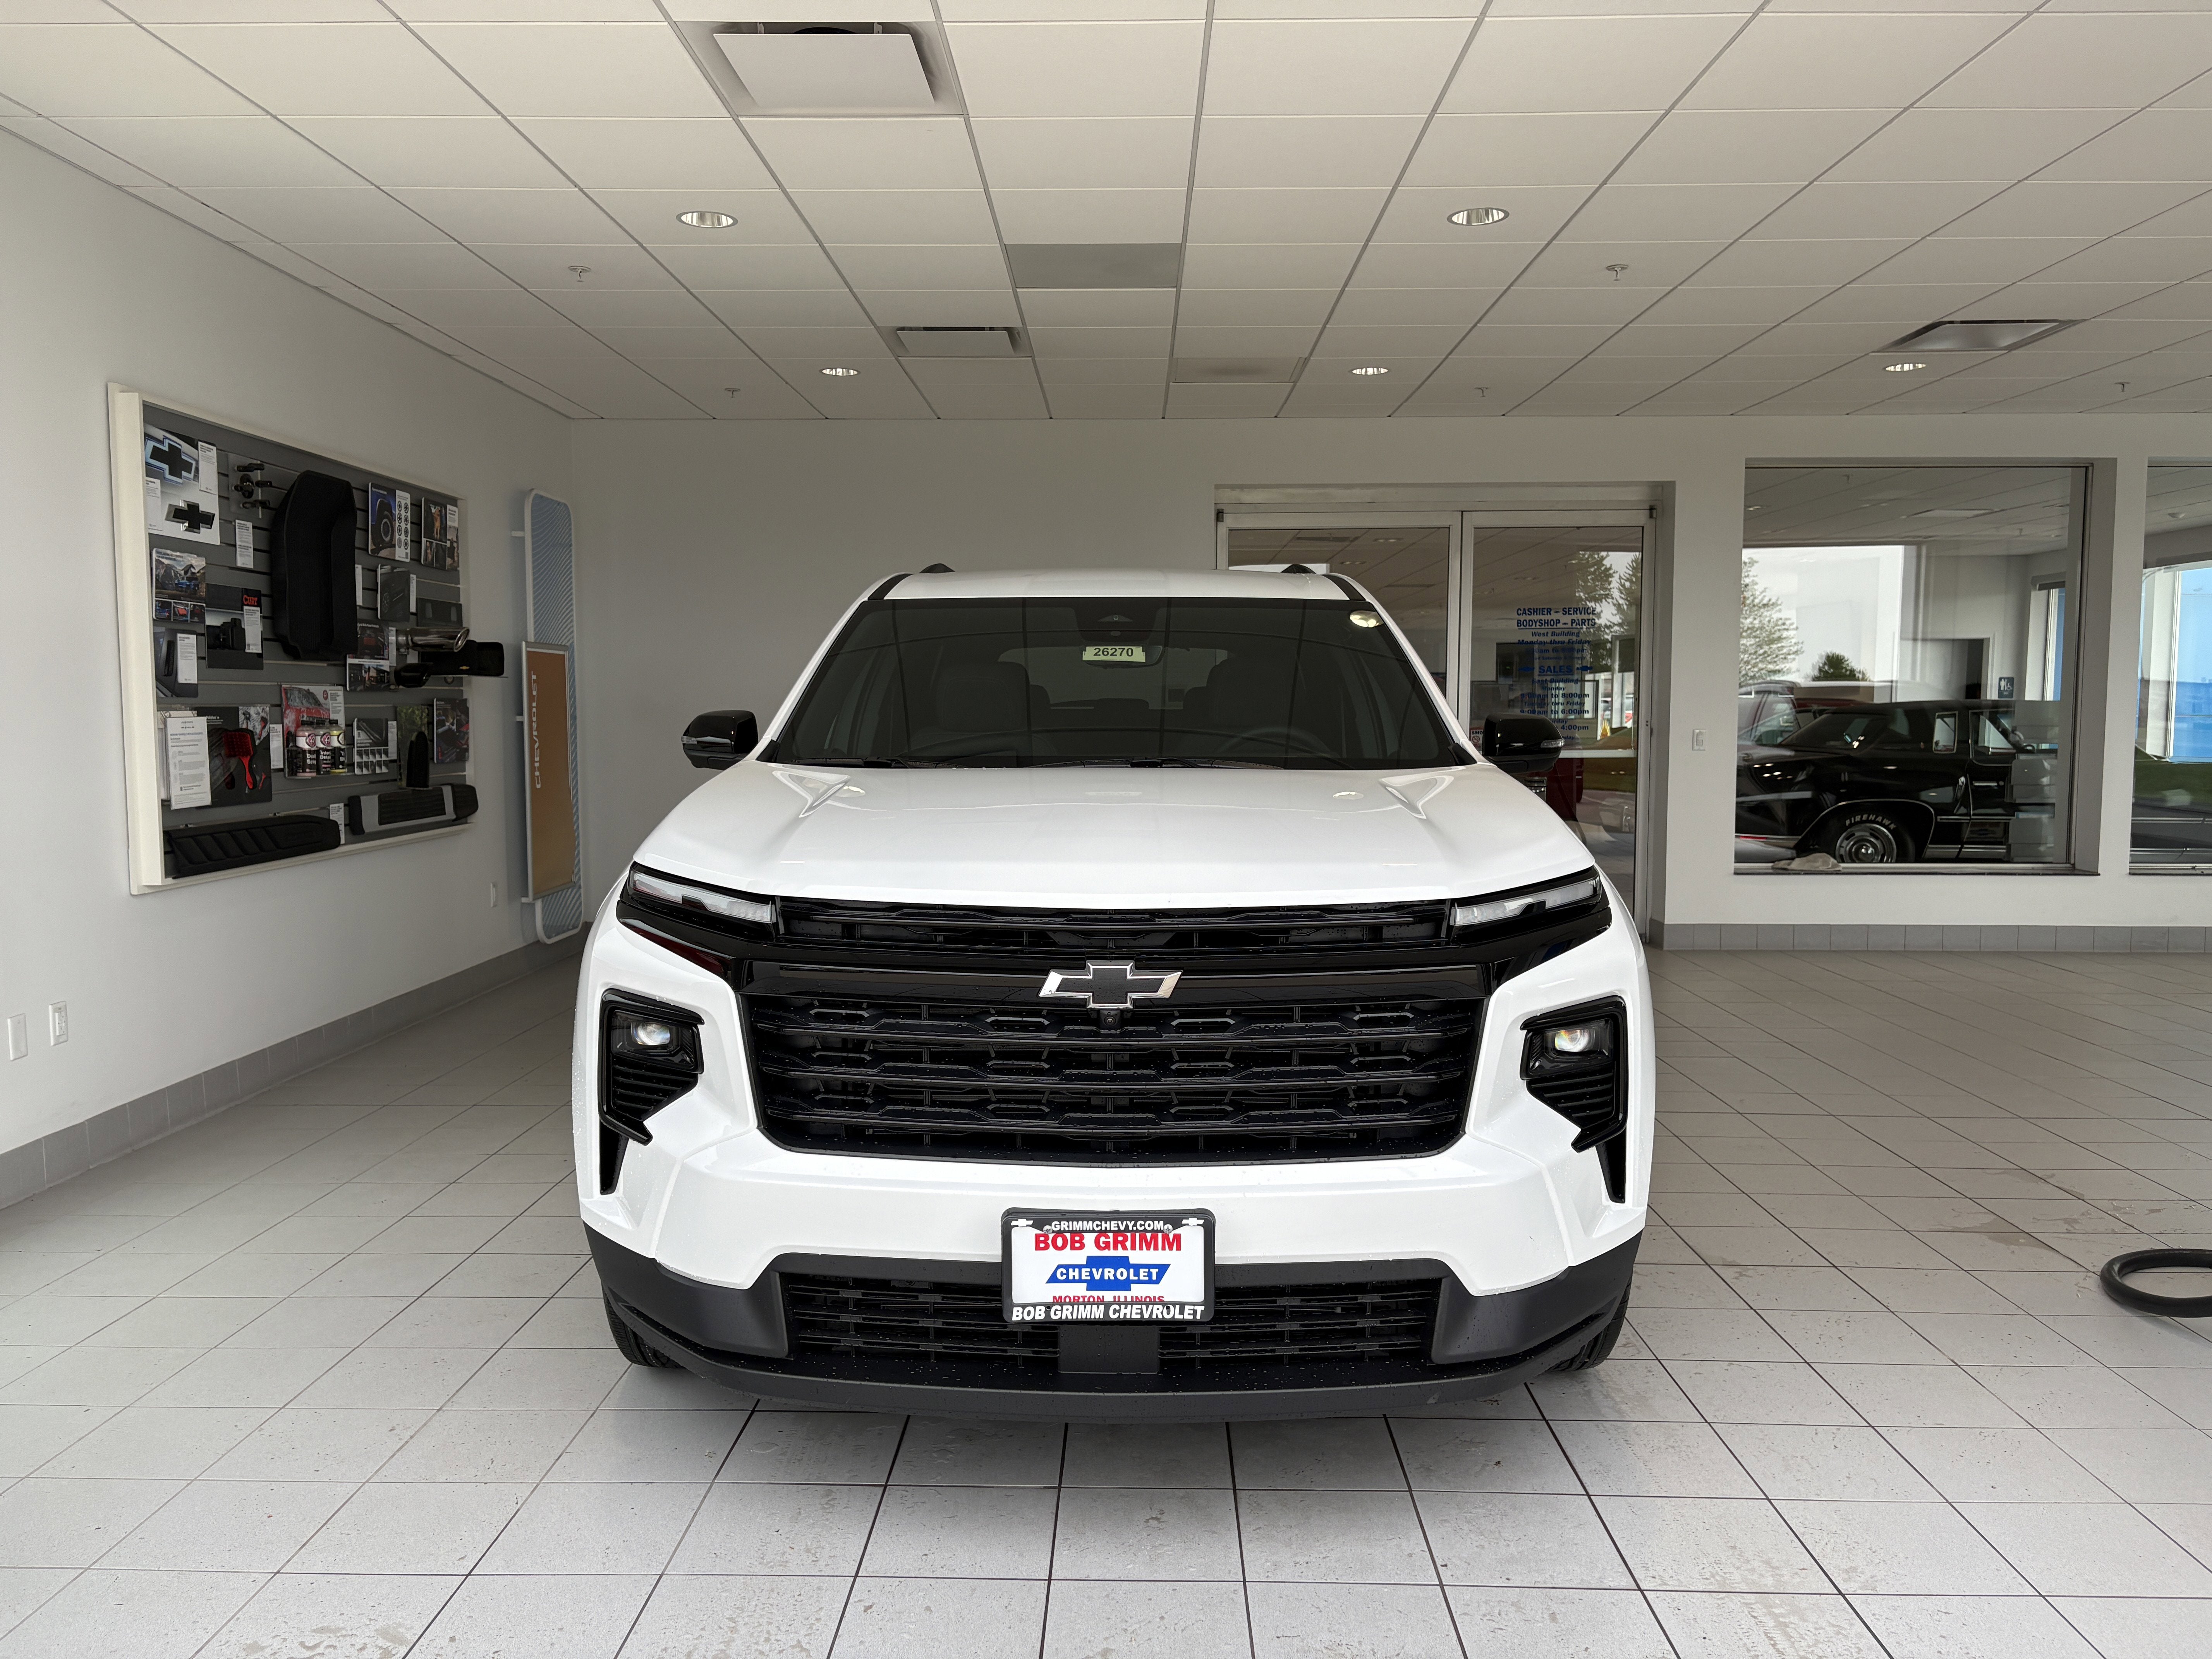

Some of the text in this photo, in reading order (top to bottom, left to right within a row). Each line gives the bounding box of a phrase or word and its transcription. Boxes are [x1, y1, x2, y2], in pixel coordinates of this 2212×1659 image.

[1516, 607, 1596, 616] CASHIER SERVICE
[1517, 618, 1596, 627] BODYSHOP PARTS
[1093, 647, 1133, 657] 26270
[1539, 665, 1573, 673] SALES
[531, 671, 541, 788] CHEVROLET
[1845, 814, 1897, 830] FIREHAWK
[1051, 1220, 1164, 1231] GRIMMCHEVY.COM
[1034, 1233, 1181, 1251] BOB GRIMM
[1056, 1268, 1159, 1280] CHEVROLET
[1012, 1304, 1205, 1321] BOB GRIMM CHEVROLET
